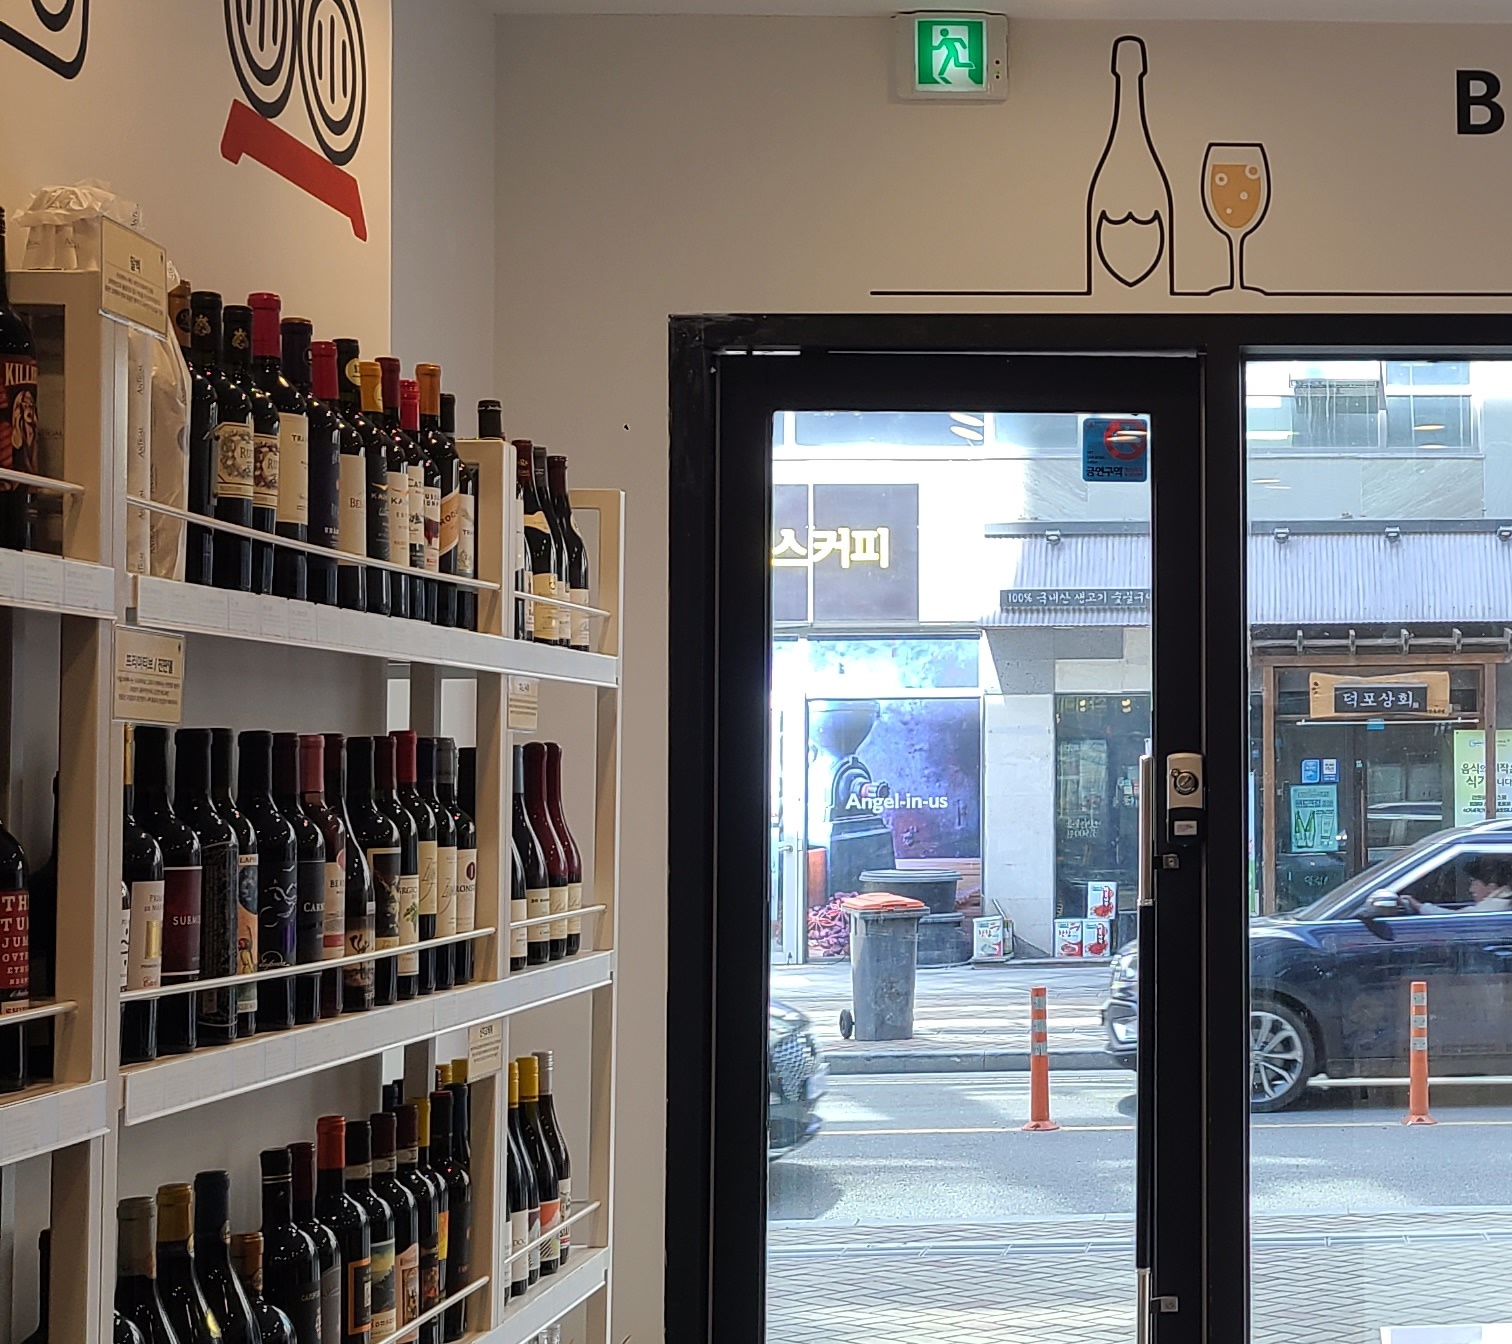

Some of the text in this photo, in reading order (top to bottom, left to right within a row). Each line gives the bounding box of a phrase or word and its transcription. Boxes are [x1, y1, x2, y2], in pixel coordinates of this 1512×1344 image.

[1008, 592, 1033, 603] 100%
[1036, 591, 1072, 604] 국내산
[1074, 591, 1108, 604] 생고기
[1343, 690, 1413, 708] 덕포상회
[845, 792, 949, 814] Angel-in-us
